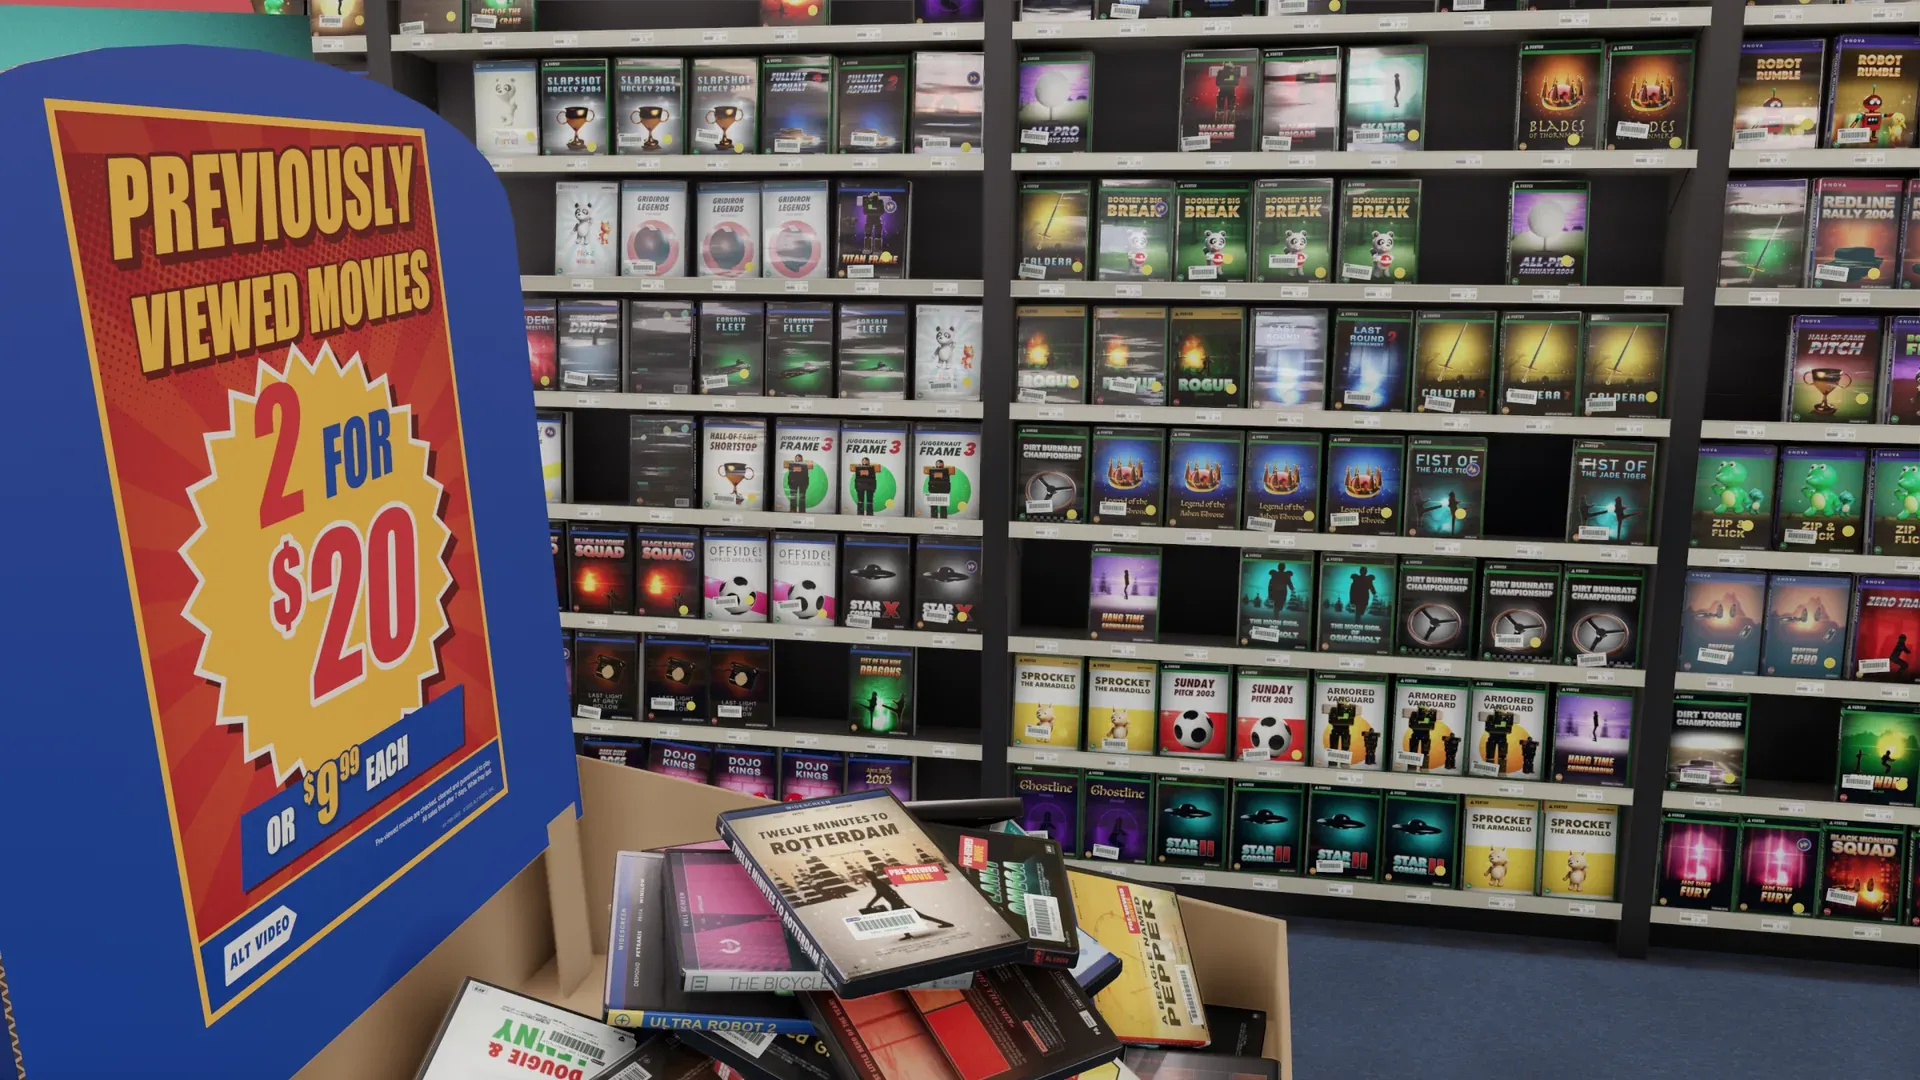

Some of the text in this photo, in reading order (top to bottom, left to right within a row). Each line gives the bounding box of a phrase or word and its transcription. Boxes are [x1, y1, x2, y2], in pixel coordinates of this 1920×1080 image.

[1757, 58, 1802, 69] ROBOT
[547, 76, 601, 85] SLAPSHOT
[846, 73, 884, 83] FULLTILT
[1756, 70, 1801, 81] RUMBLE
[846, 84, 883, 94] ASPHALT
[1529, 120, 1585, 132] BLADES
[107, 144, 414, 261] PREVIOUSLY
[637, 195, 670, 203] GRIDIRON
[1822, 196, 1895, 208] REDLINE
[637, 203, 669, 212] LEGENDS
[1184, 205, 1240, 218] BREAK
[1822, 209, 1895, 220] RALLY 2004
[842, 254, 899, 264] TITAN FRAE
[1518, 268, 1554, 276] FAIRWAYS
[131, 249, 430, 373] VIEWED MOVIES
[716, 323, 746, 332] FLEET
[1354, 326, 1382, 334] LAST
[1350, 334, 1384, 343] ROUND
[1808, 334, 1866, 342] HALL-OF-FAME
[1808, 342, 1864, 356] PITCH
[710, 442, 758, 452] SHORTSTOP
[846, 440, 902, 455] FRAME 3
[1023, 444, 1040, 452] DIRT
[254, 381, 393, 530] 2 FOR
[1023, 452, 1082, 460] CHAMPIONSHIP
[1581, 458, 1648, 472] FIST OF
[1581, 470, 1597, 478] THE
[1623, 472, 1647, 480] TIGER
[1180, 500, 1225, 509] Legend of the
[1200, 510, 1224, 518] Throne
[1712, 518, 1732, 528] ZIP
[1711, 529, 1745, 538] FLICK
[574, 545, 625, 558] SQUAD
[779, 549, 831, 560] OFFSIDE!
[270, 502, 420, 704] $20
[1867, 596, 1896, 608] ZERO
[850, 600, 900, 618] STAR X
[1102, 612, 1144, 623] HANG TIME
[860, 665, 902, 677] DRAGONS
[1021, 672, 1076, 683] SPROCKET
[1035, 681, 1076, 690] ARMADILLO
[1174, 678, 1215, 689] SUNDAY
[1174, 688, 1216, 698] PITCH 2003
[1408, 691, 1457, 702] ARMORED
[1408, 700, 1456, 709] VANGUARD
[1676, 710, 1742, 721] DIRT TORQUE
[1676, 718, 1742, 728] CHAMPIONSHIP
[728, 756, 762, 768] DOJO
[728, 766, 761, 777] KINGS
[866, 774, 892, 785] 2003
[267, 806, 296, 855] OR
[366, 734, 408, 792] EACH
[1090, 784, 1145, 800] Ghostline
[785, 799, 832, 812] WIDESCREEN
[758, 812, 888, 840] TWELVE MINUTES TO
[375, 824, 399, 847] Pre-viewed
[769, 822, 900, 855] ROTTERDAM
[1830, 834, 1858, 842] BLACK
[1166, 837, 1198, 849] STAR
[1166, 847, 1198, 857] CORSAIR
[1831, 841, 1896, 858] SQUAD
[888, 866, 940, 876] PRE-VIEWED
[903, 872, 934, 882] MOVIE
[1002, 861, 1028, 916] OMEGA
[1680, 886, 1712, 898] FURY
[730, 841, 821, 967] TWELVE MINUTES TO ROTTERDAM
[1120, 888, 1134, 932] PRE-VIEWED
[618, 908, 626, 951] WIDESCREEN
[230, 914, 290, 971] ALT VIDEO
[1134, 896, 1168, 1025] A BEAGLE NAMED
[1142, 899, 1182, 1027] PEPPER
[633, 962, 641, 988] DESMOND
[728, 976, 829, 990] THE BICYCLE
[650, 1016, 777, 1033] ULTRA ROBOT 2
[488, 1040, 584, 1080] DOUGIE &
